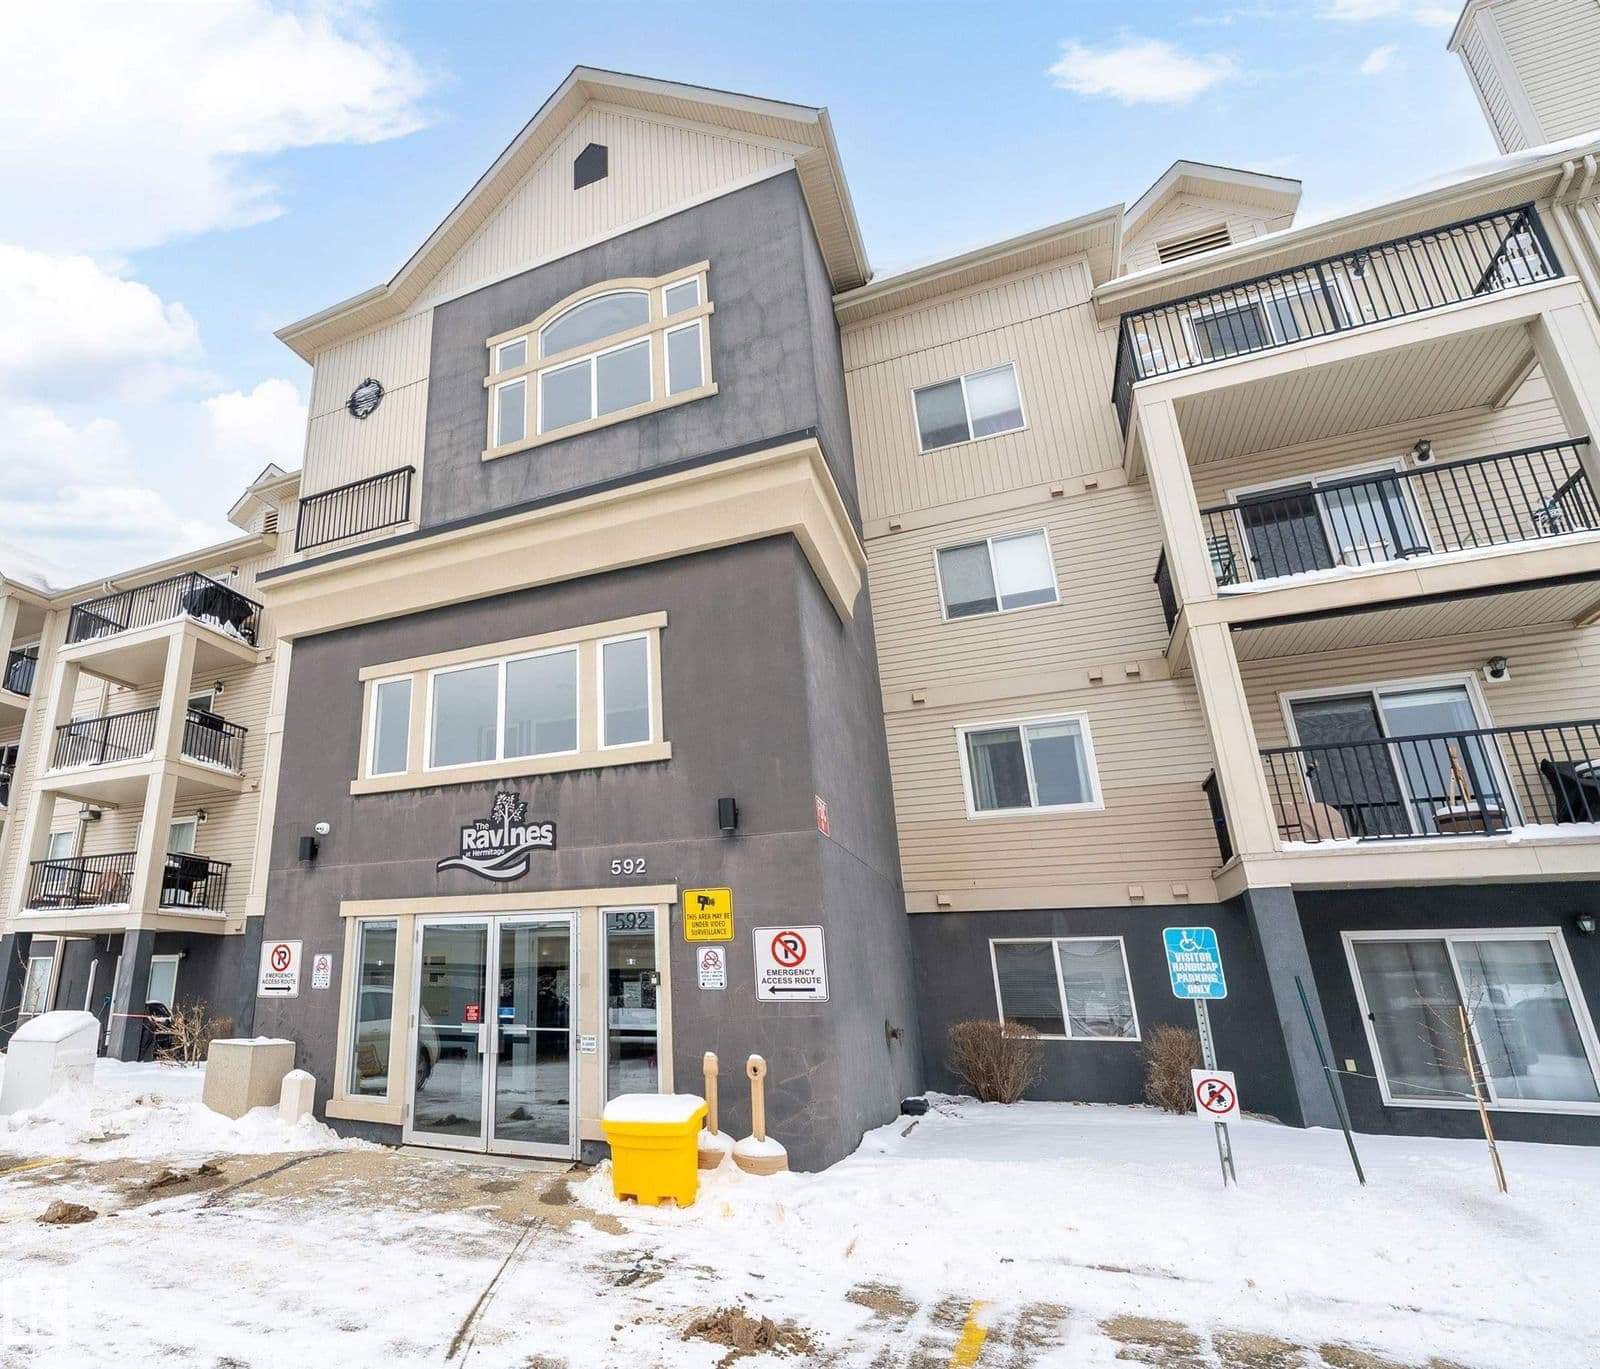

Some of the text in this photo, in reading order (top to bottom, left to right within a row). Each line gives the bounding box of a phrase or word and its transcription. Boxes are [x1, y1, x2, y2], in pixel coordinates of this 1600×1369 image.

[475, 822, 490, 830] The
[472, 848, 505, 857] Hermitage
[610, 858, 647, 875] 592
[614, 911, 649, 930] 592
[710, 920, 726, 928] VIDEO
[691, 928, 727, 936] SURVEILLANCE
[1174, 952, 1212, 962] VISITOR
[1172, 962, 1218, 972] HANDICAP
[761, 976, 822, 985] ACCESS ROUTE
[1177, 973, 1218, 983] PARKING
[1188, 984, 1211, 994] ONLY
